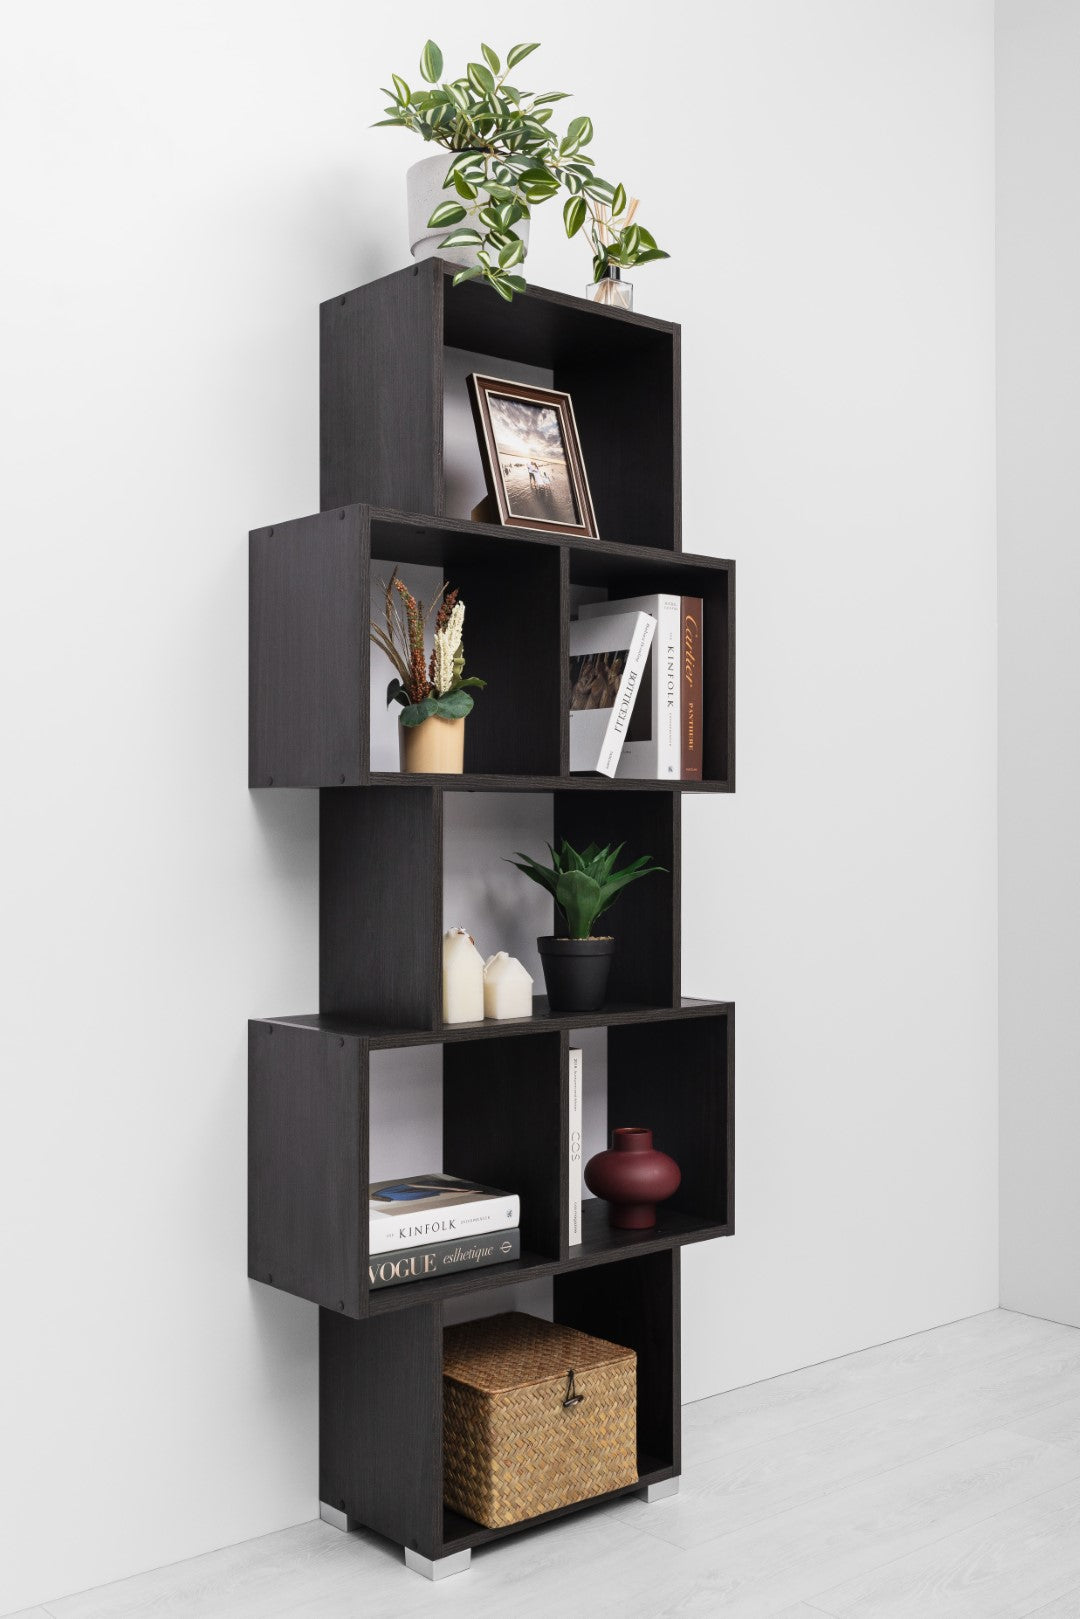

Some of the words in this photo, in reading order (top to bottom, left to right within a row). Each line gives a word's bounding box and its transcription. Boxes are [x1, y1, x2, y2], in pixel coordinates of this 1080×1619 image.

[685, 615, 698, 687] Cartier
[614, 670, 637, 733] BOTTICELLI
[571, 1131, 580, 1162] COS
[399, 1219, 457, 1239] KINFOLK
[369, 1253, 437, 1284] VOGUE
